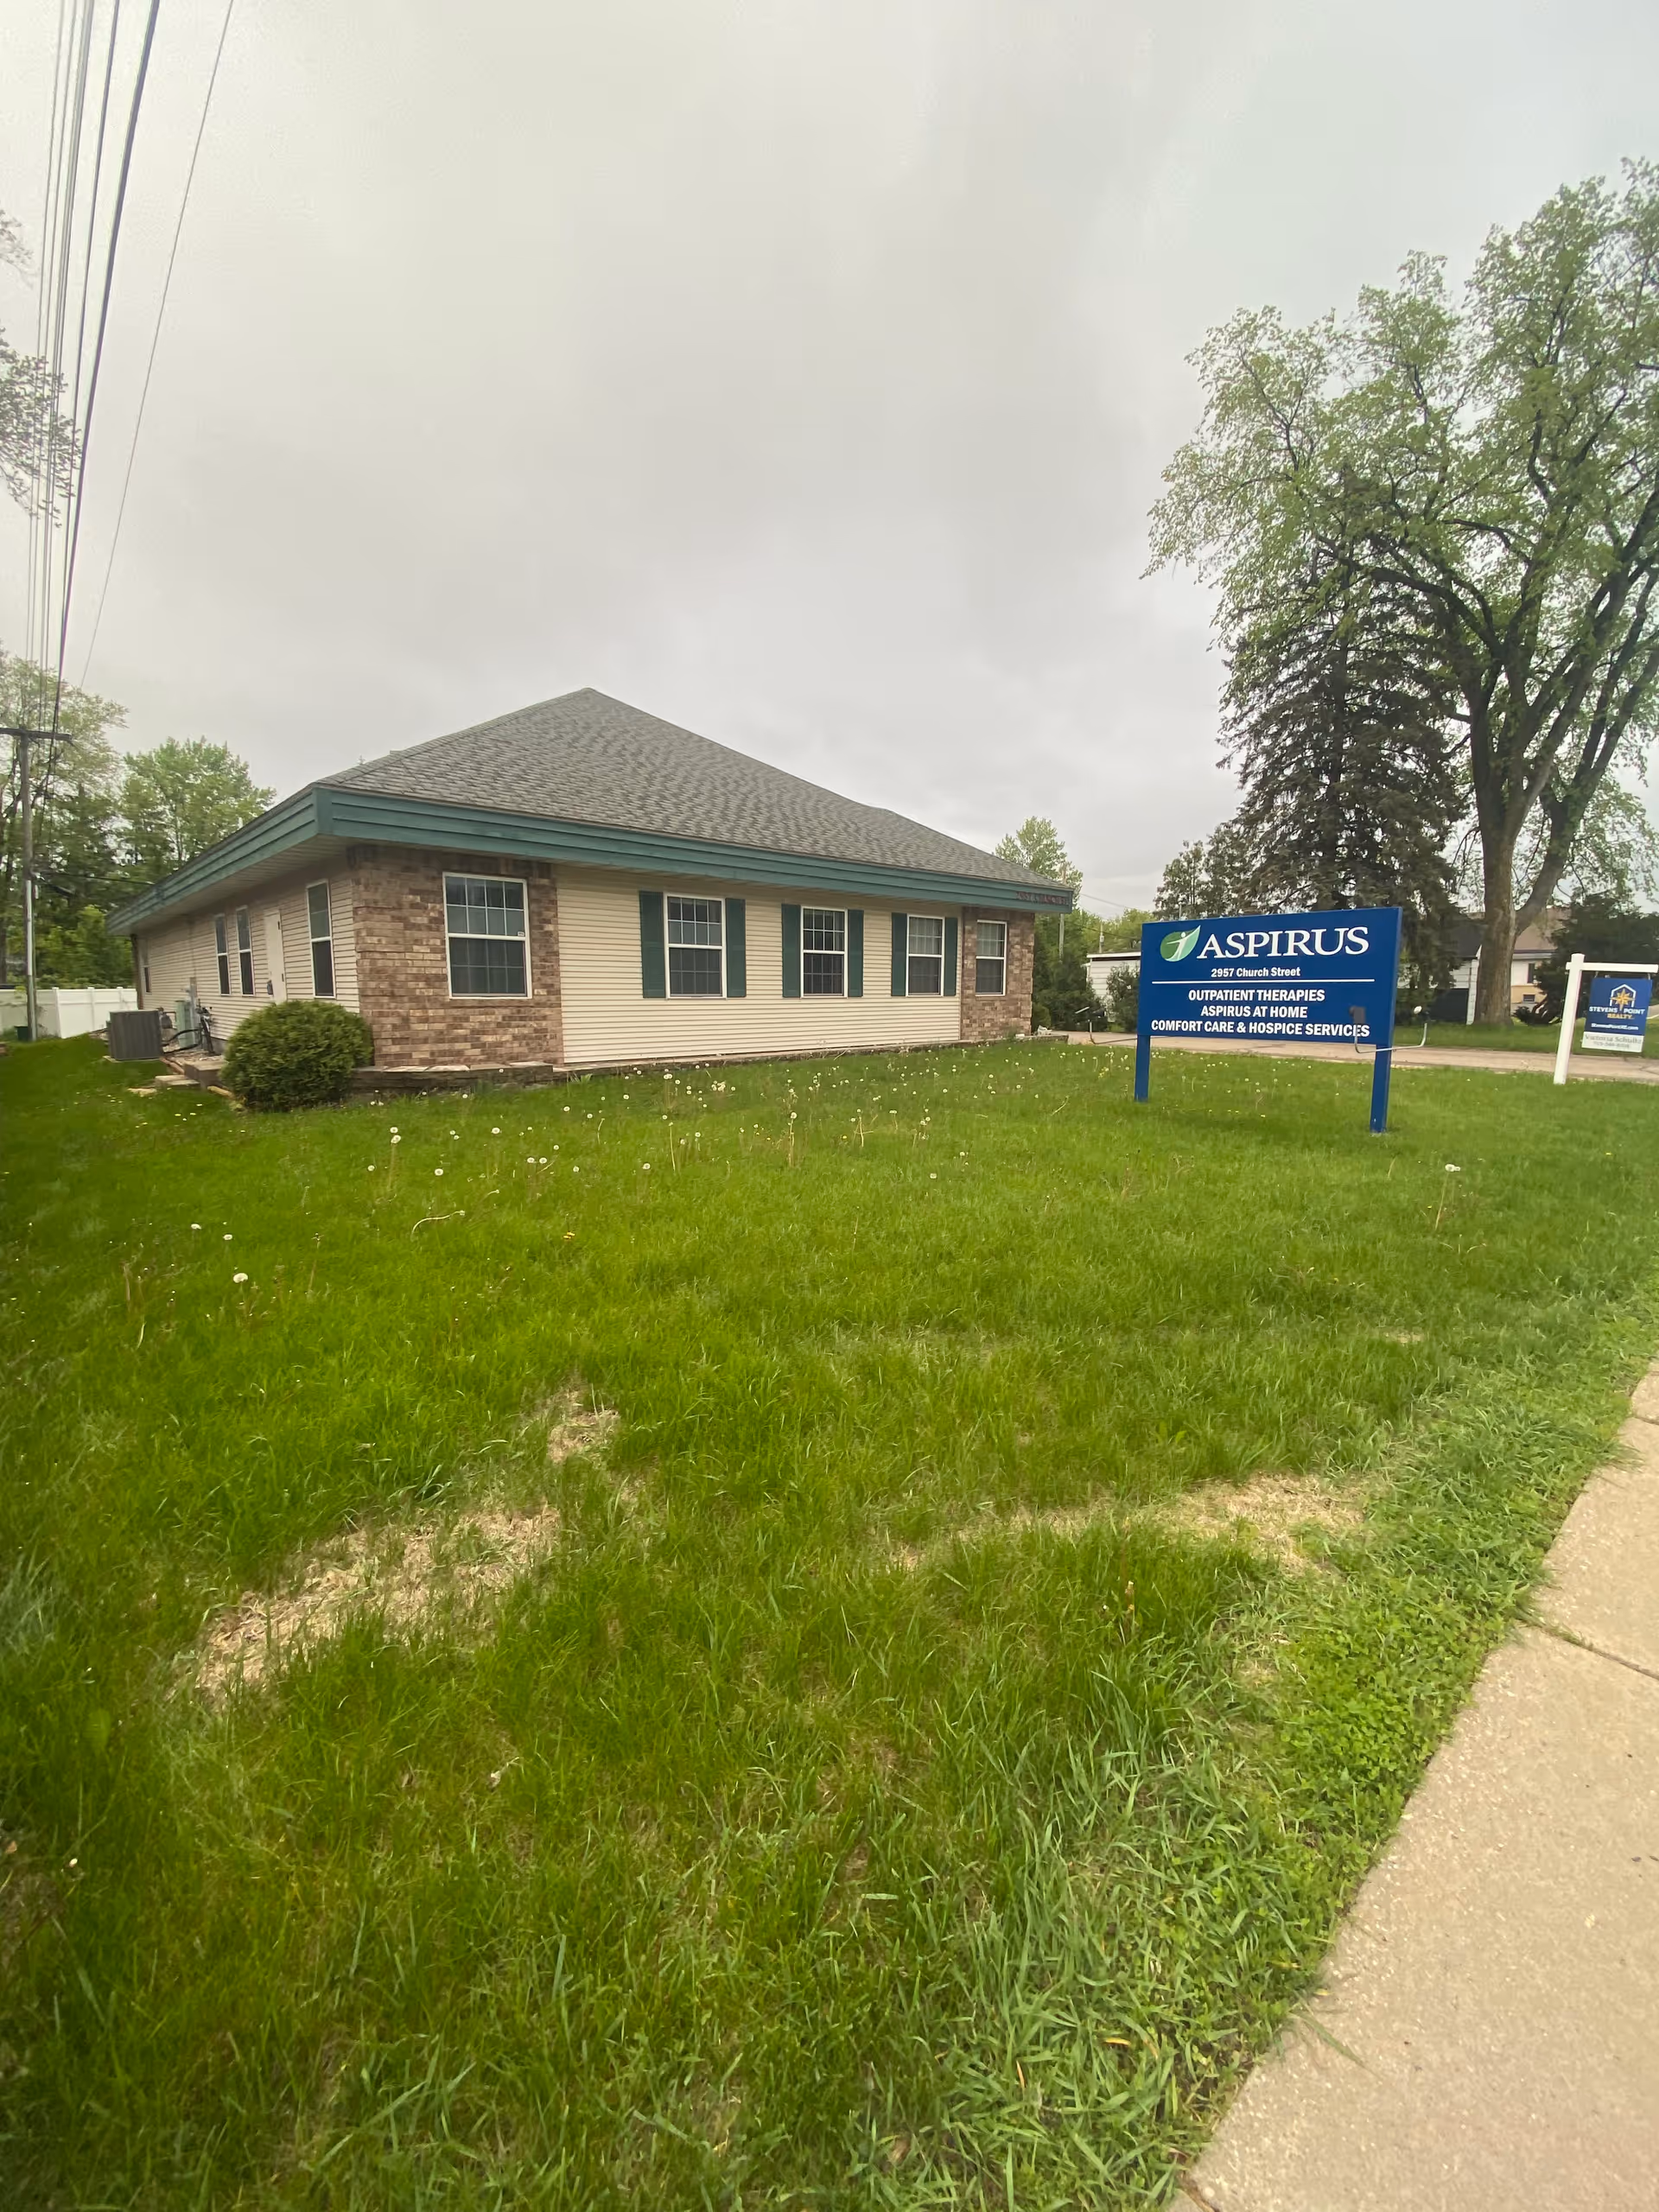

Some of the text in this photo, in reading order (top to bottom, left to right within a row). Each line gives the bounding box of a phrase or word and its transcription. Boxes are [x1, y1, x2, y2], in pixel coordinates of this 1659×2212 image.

[1197, 926, 1370, 959] ASPIRUS
[1211, 966, 1300, 977] 2957 Church Street
[1188, 989, 1325, 1001] OUTPATIENT THERAPIES
[1200, 1005, 1308, 1018] ASPIRUS AT HOME
[1151, 1020, 1370, 1037] COMFORT CARE & HOSPICE SERVICES
